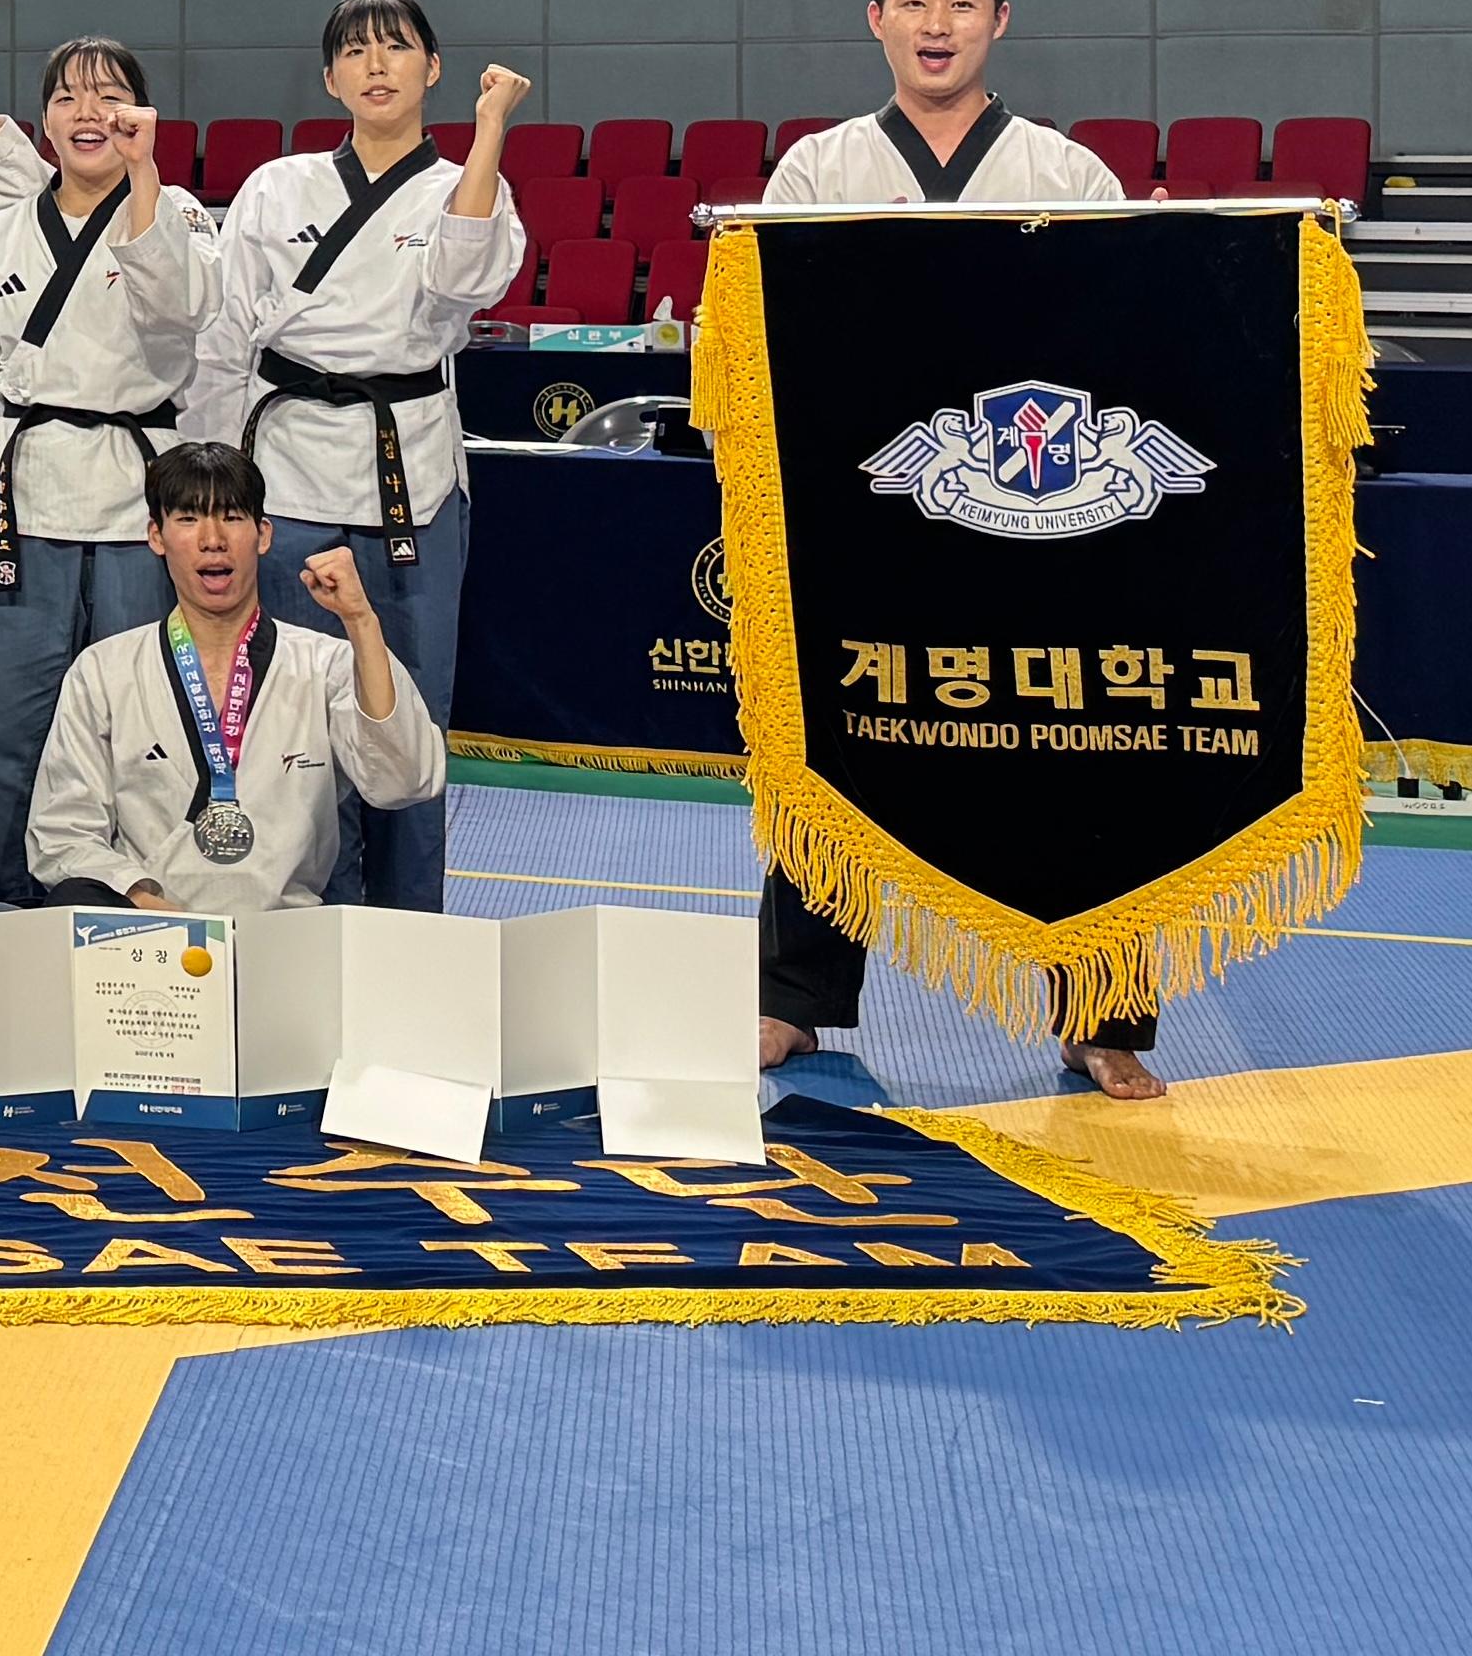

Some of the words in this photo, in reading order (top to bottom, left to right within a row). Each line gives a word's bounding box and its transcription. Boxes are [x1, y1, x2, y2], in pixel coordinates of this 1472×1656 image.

[996, 426, 1020, 448] 계
[1047, 443, 1071, 465] 명
[959, 501, 1030, 530] KEIMYUNG
[1035, 501, 1117, 530] UNIVERSITY
[653, 679, 728, 694] SHINHAN
[840, 639, 1261, 712] 계명대학교
[186, 670, 216, 734] 신한대학교
[225, 673, 246, 737] 신한대학교
[842, 708, 1019, 750] TAEKWONDO
[1031, 723, 1167, 753] POOMSAE
[1177, 724, 1259, 756] TEAM
[207, 743, 226, 775] 제5회
[418, 1238, 1033, 1273] TEAM
